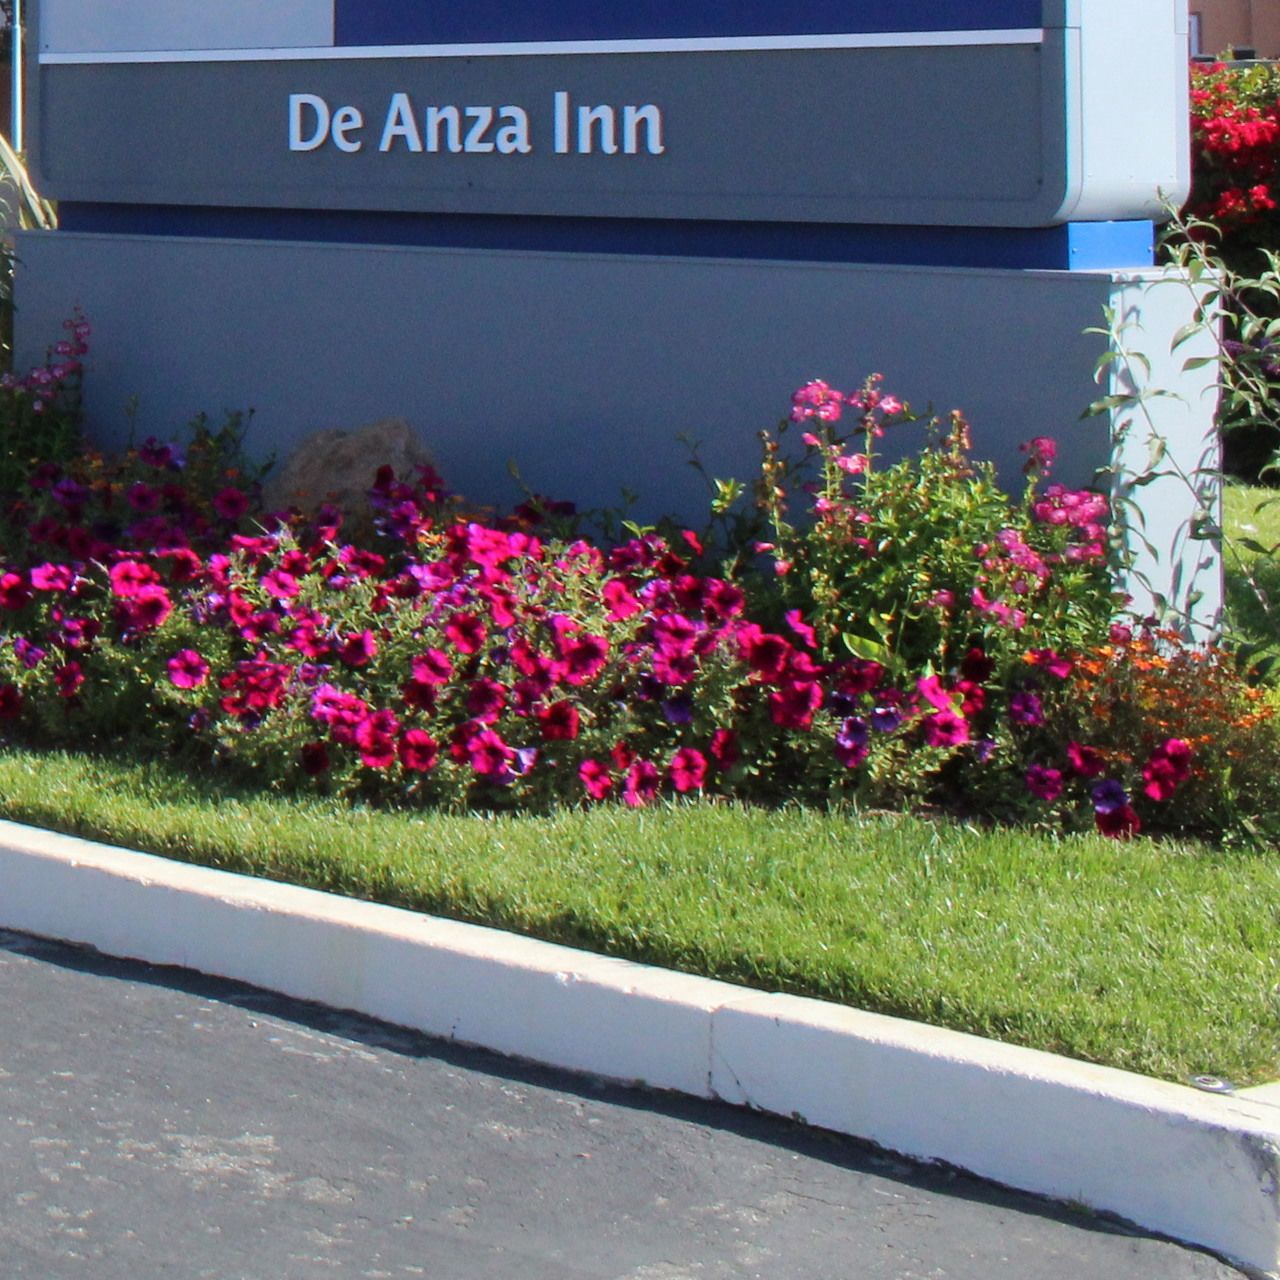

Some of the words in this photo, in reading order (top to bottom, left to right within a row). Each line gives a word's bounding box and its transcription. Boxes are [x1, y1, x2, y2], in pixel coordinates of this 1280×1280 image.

[289, 94, 363, 153] De
[379, 93, 532, 154] Anza
[555, 92, 665, 155] Inn
